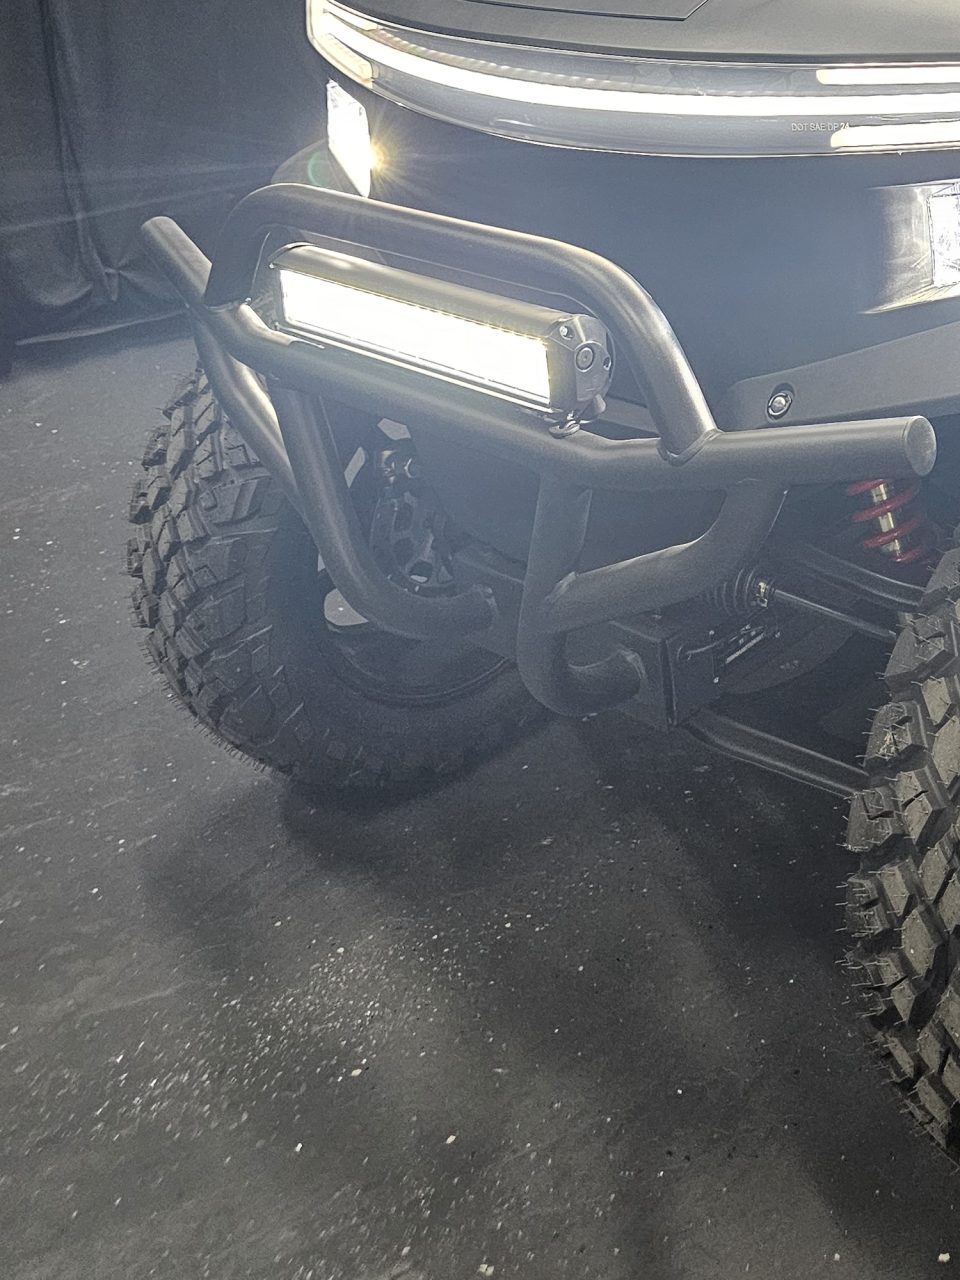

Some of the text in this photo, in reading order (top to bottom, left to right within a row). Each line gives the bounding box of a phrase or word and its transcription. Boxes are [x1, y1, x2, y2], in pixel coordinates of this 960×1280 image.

[791, 122, 808, 131] DOT
[809, 122, 826, 131] SAE
[827, 122, 839, 131] DP
